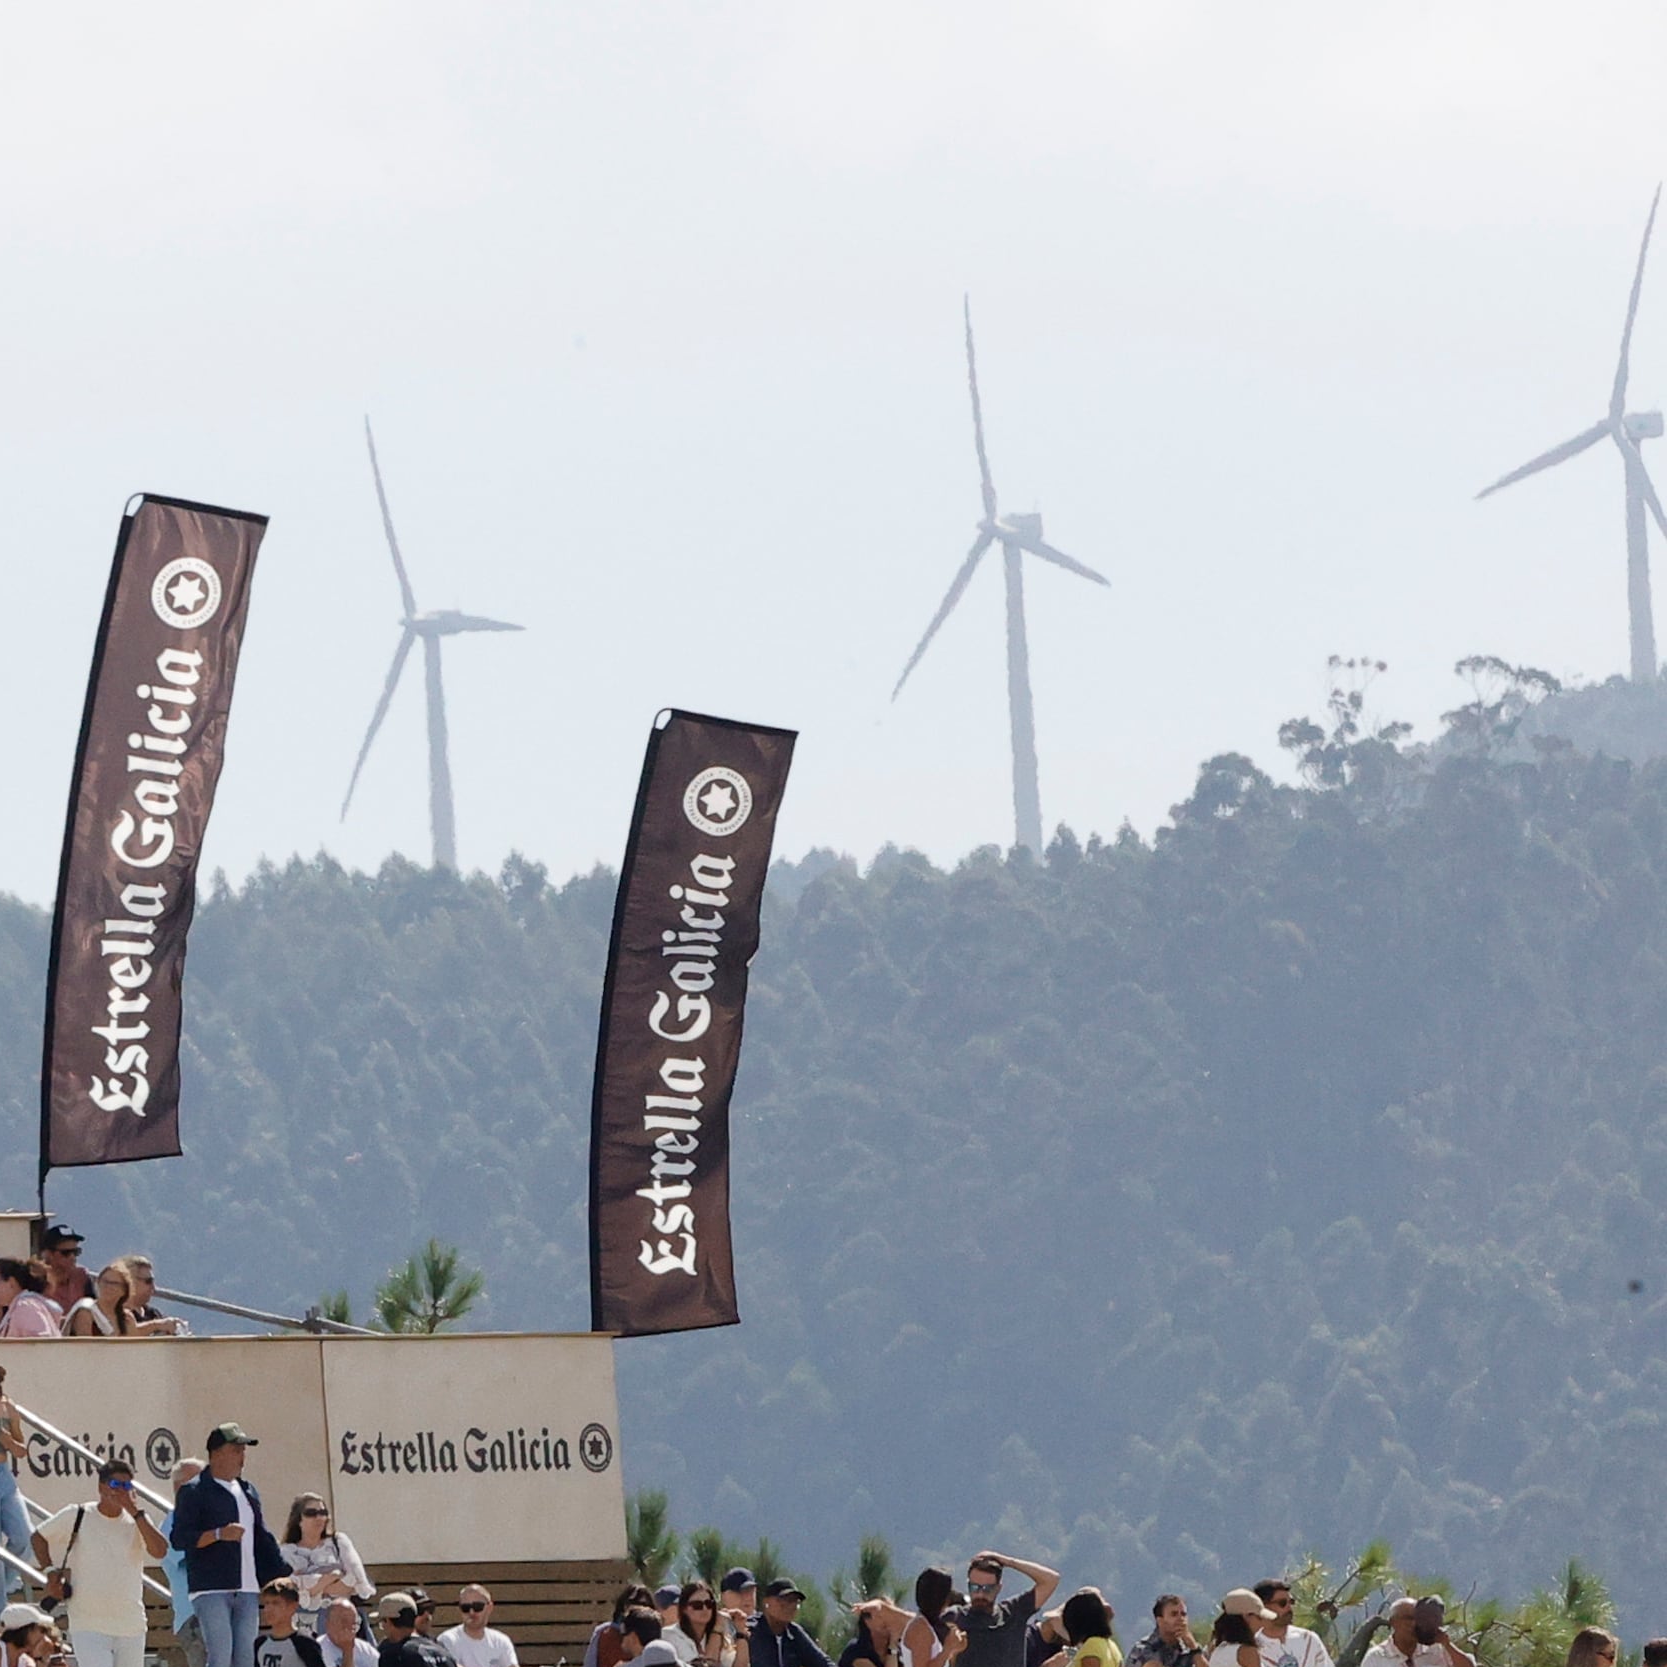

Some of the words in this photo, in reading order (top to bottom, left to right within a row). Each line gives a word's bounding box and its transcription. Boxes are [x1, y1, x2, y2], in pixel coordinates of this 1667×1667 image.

[111, 647, 205, 869] Galicia
[88, 882, 167, 1118] Estrella
[648, 852, 736, 1043] Galicia
[635, 1056, 707, 1276] Estrella
[340, 1431, 458, 1476] Estrella
[464, 1428, 572, 1473] Galicia
